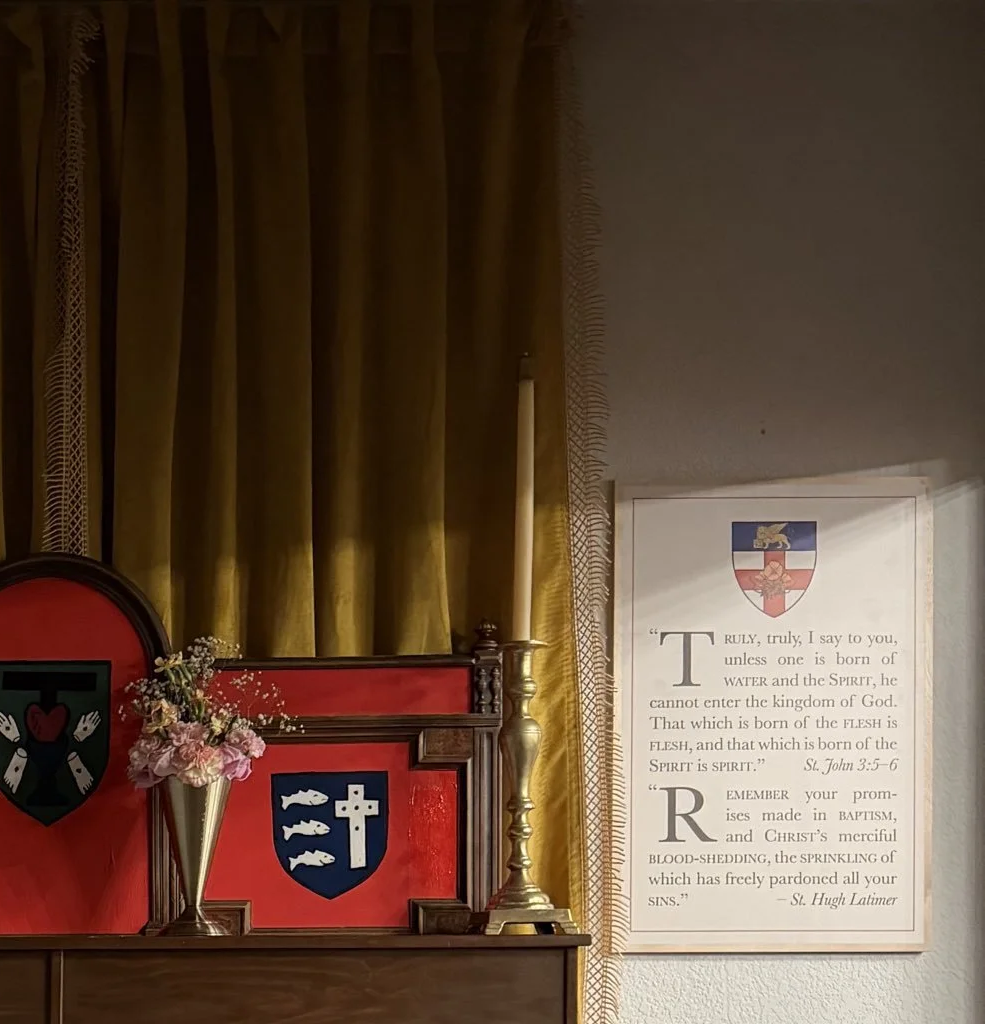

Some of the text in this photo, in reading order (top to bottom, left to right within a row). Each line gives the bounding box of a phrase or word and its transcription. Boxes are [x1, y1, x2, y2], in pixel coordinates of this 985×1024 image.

[767, 631, 802, 648] truly,
[807, 631, 814, 643] I
[819, 636, 843, 647] say
[847, 634, 862, 643] to
[867, 635, 898, 647] you,
[724, 652, 898, 665] unless one is born of
[724, 673, 898, 688] WATER and the SPIRIT, he
[649, 695, 898, 711] cannot enter the kingdom of God.
[649, 716, 898, 729] That which is born of the FLESH is
[649, 737, 898, 753] FLESH, and that which is born of the
[649, 760, 693, 772] SPIRIT
[697, 759, 708, 771] is
[821, 758, 854, 775] John
[804, 791, 838, 803] your
[853, 791, 898, 803] prom-
[726, 808, 897, 823] ises made in BAPTISM,
[725, 829, 753, 842] and
[838, 829, 897, 842] merciful
[649, 850, 897, 864] BLOOD-SHEDDING, the SPRINKLING of
[648, 872, 897, 888] which has freely pardoned all your
[811, 893, 846, 908] Hugh
[849, 893, 898, 905] Latimer
